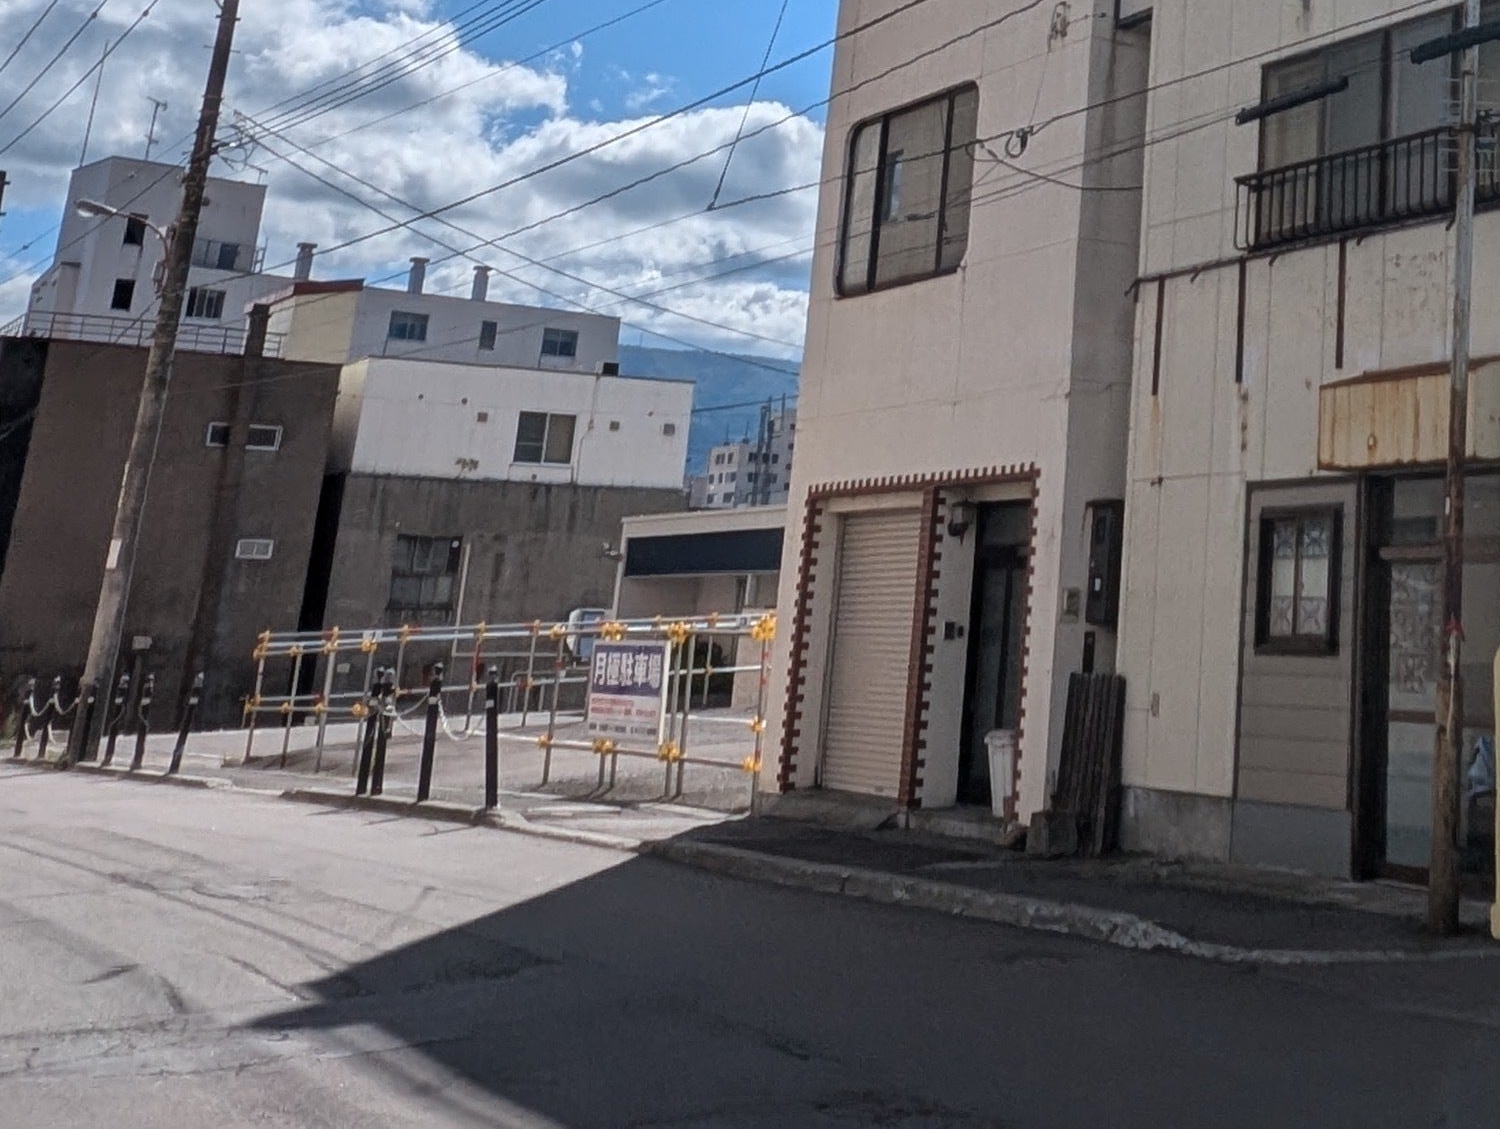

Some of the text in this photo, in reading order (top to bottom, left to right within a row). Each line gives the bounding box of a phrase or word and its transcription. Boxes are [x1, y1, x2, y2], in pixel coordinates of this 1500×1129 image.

[594, 652, 662, 688] 月極駐車場
